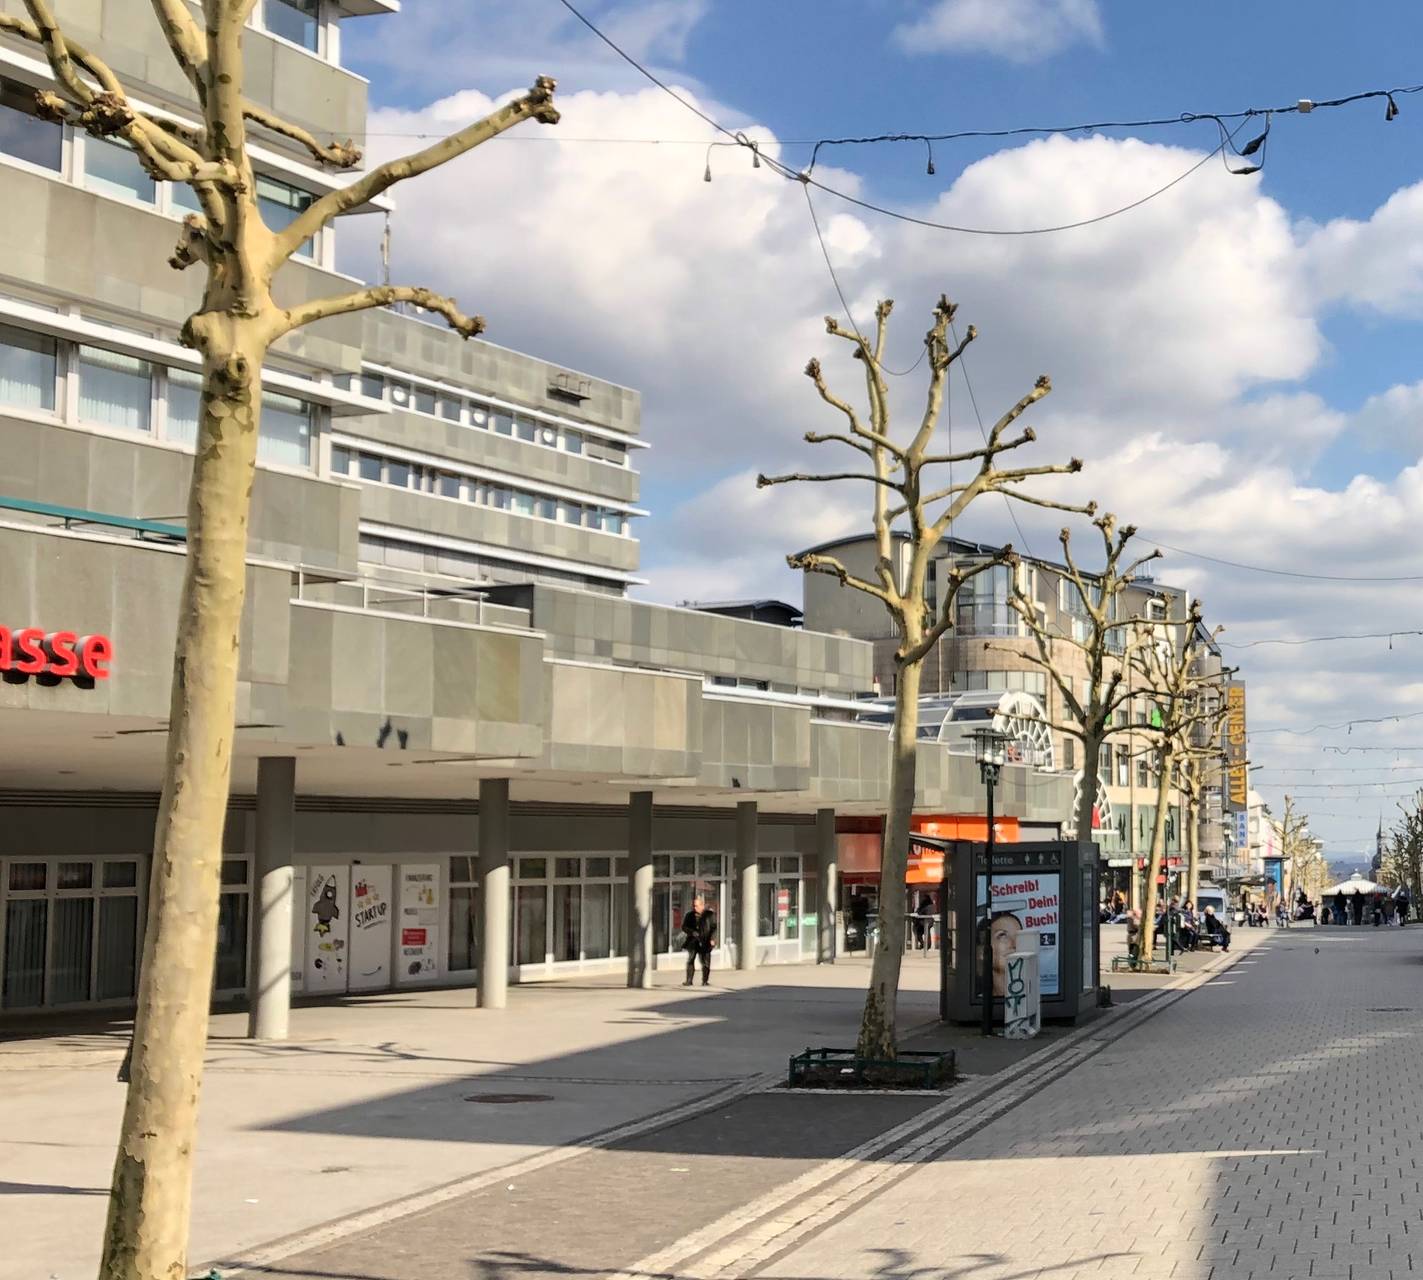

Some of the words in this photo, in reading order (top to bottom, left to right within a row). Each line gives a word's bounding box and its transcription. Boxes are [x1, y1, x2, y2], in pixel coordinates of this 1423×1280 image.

[977, 855, 1014, 865] Tolette
[991, 879, 1040, 897] Schreib!
[1028, 895, 1058, 910] Dein!
[1025, 912, 1058, 928] Buch!
